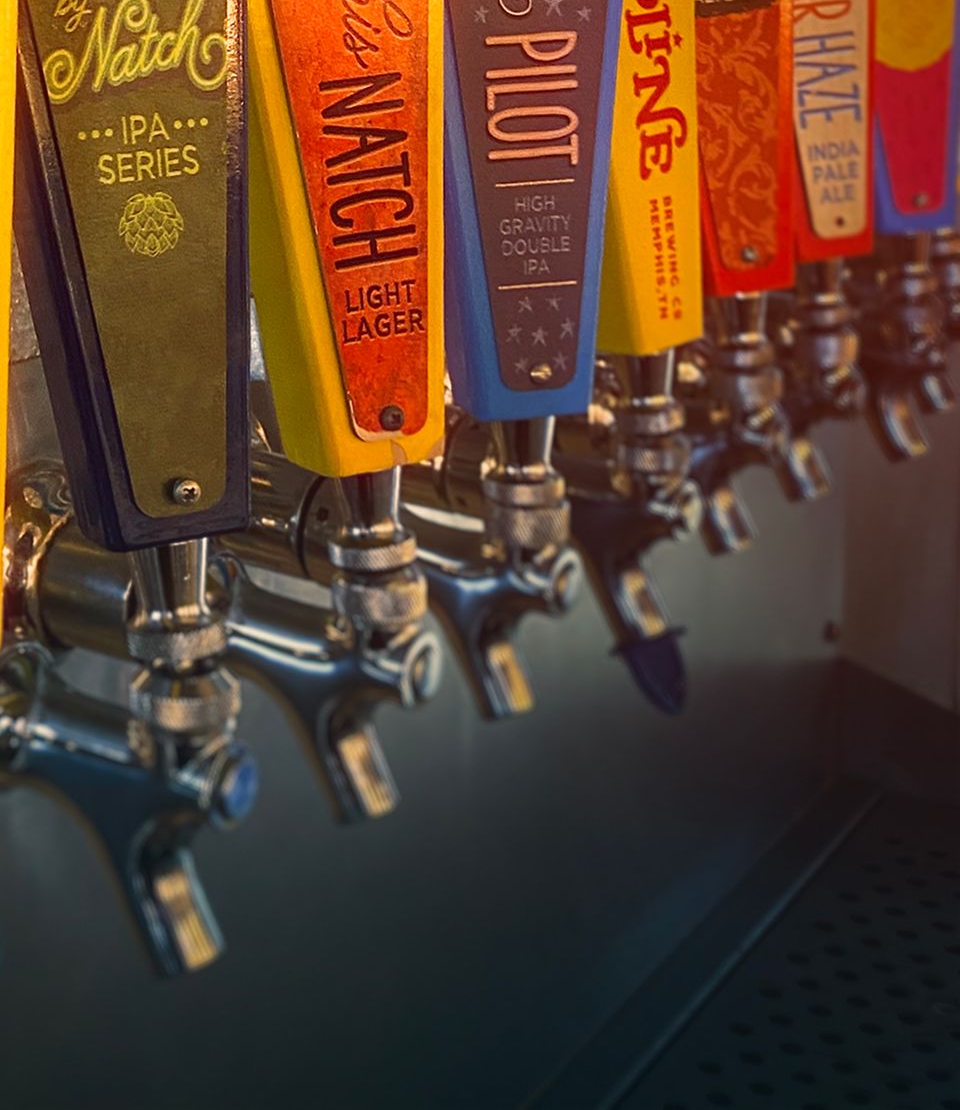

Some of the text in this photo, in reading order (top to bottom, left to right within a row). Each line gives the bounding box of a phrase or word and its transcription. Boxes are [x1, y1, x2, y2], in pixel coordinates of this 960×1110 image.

[794, 30, 861, 129] HAZE
[485, 30, 579, 166] PILOT
[121, 112, 170, 146] IPA
[98, 145, 200, 185] SERIES
[808, 141, 859, 161] INDIA
[319, 71, 419, 271] NATCH
[813, 162, 859, 184] PALE
[514, 195, 556, 213] HIGH
[820, 184, 856, 205] ALE
[499, 215, 571, 236] GRAVITY
[663, 196, 680, 287] BREWING
[501, 236, 571, 257] DOUBLE
[523, 259, 550, 276] IPA
[344, 279, 417, 314] LIGHT
[342, 308, 425, 344] LAGER
